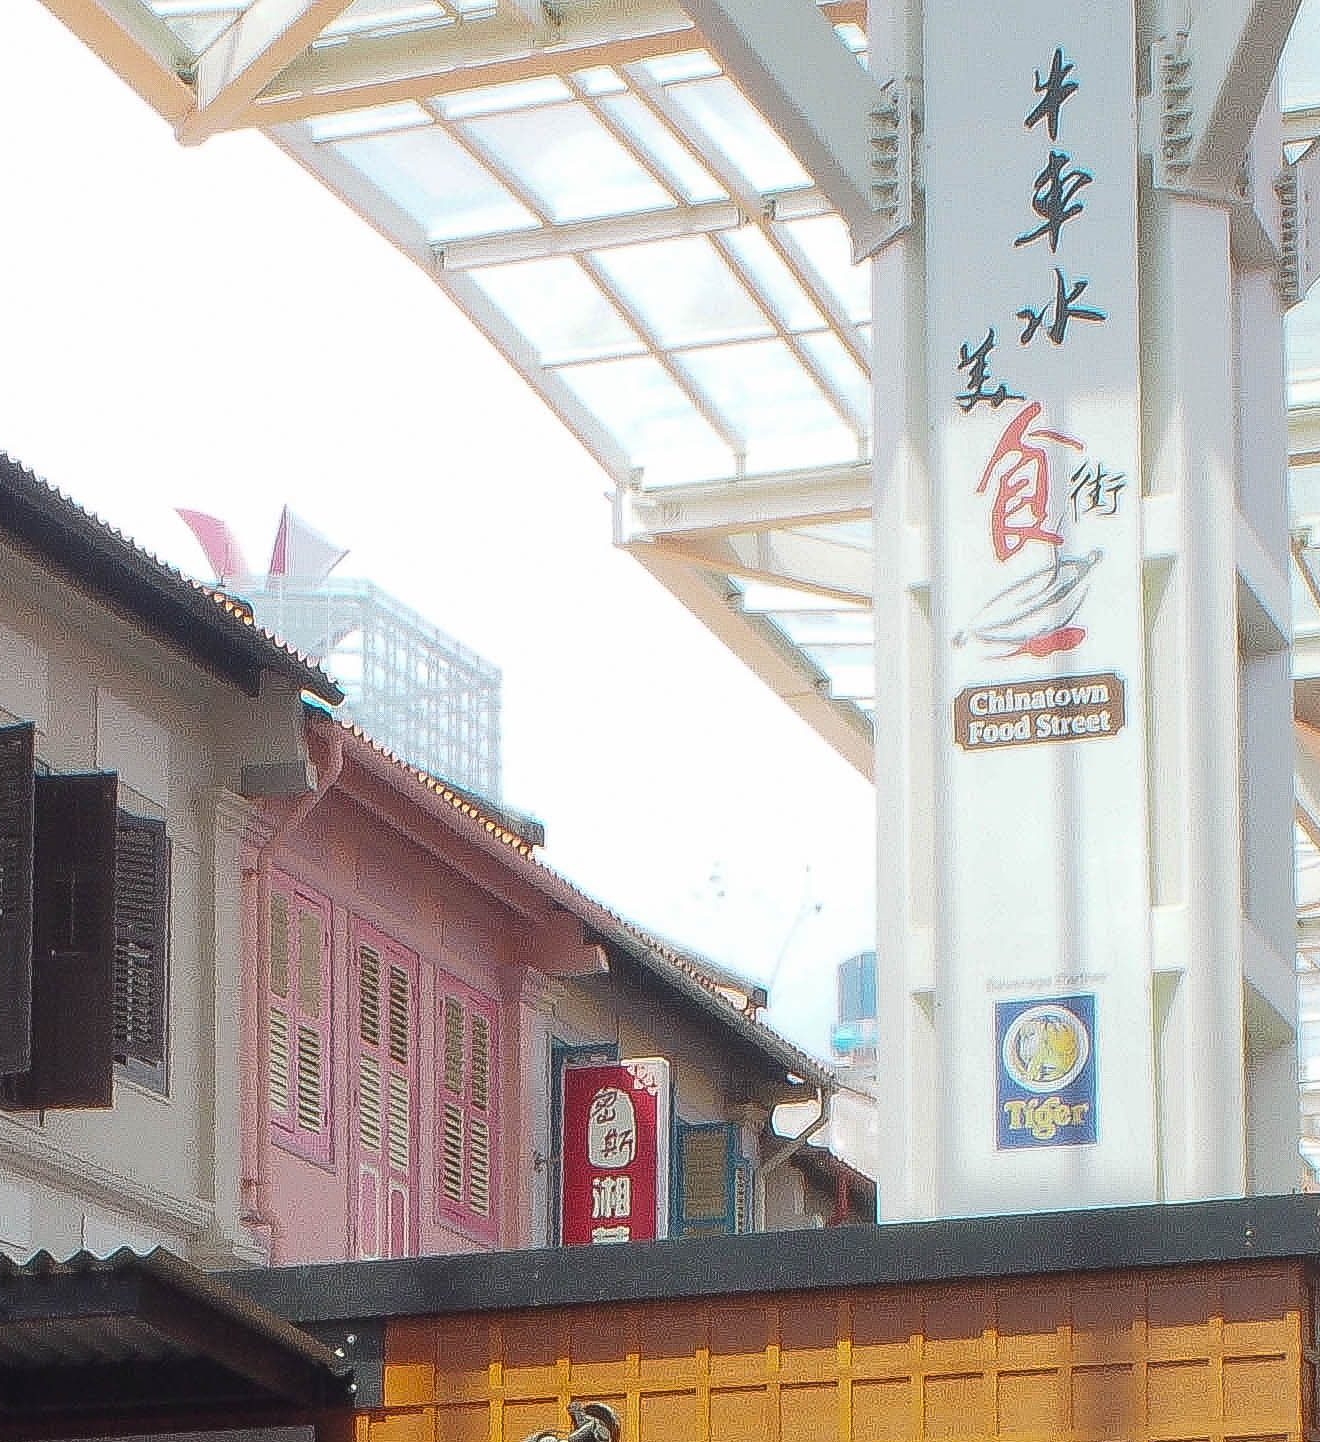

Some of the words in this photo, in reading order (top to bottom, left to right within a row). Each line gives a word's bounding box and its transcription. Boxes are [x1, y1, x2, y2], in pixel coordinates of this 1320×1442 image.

[969, 684, 1110, 716] Chinatown
[967, 715, 1030, 745] Food
[1035, 710, 1113, 738] Street
[1003, 1096, 1089, 1140] Tiger
